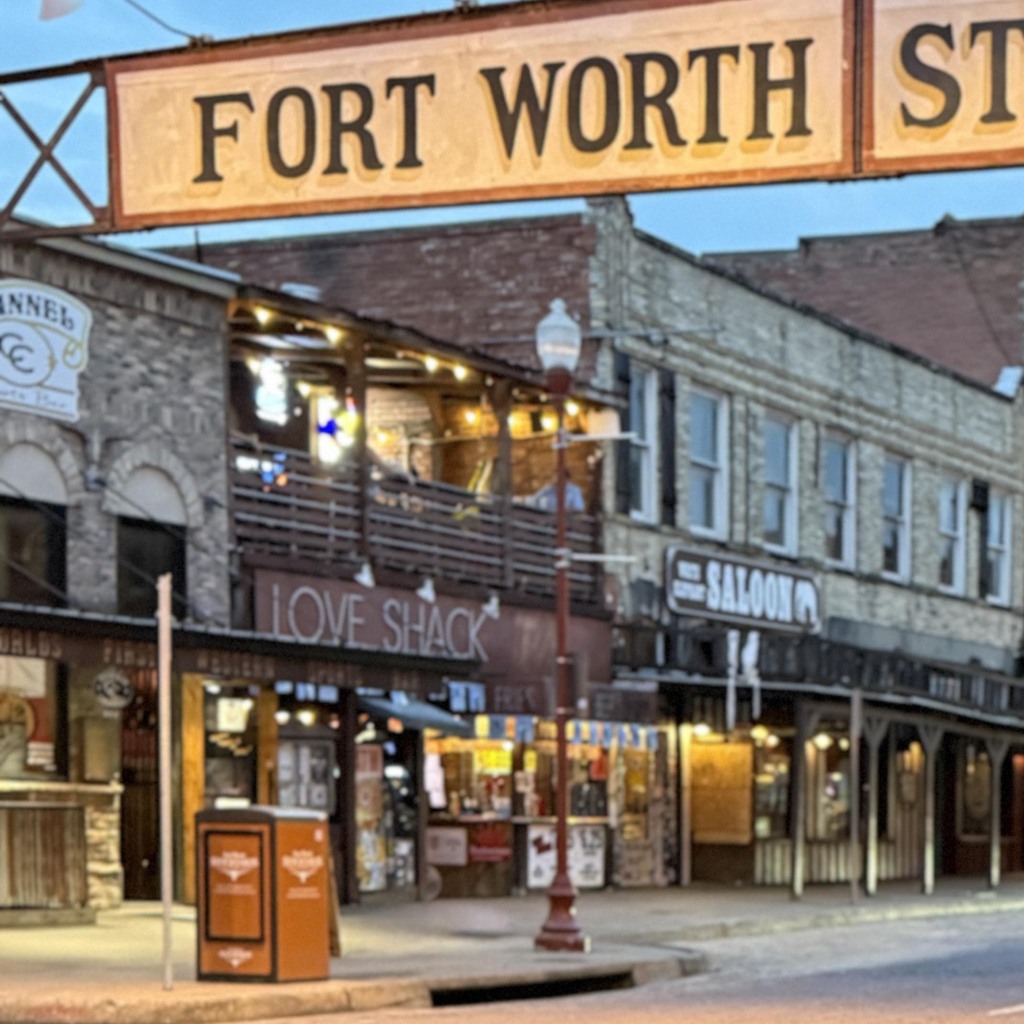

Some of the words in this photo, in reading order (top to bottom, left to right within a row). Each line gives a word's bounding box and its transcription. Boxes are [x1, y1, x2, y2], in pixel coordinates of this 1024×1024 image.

[192, 74, 436, 184] FORT
[480, 38, 815, 161] WORTH
[272, 584, 368, 650] LOVE
[383, 598, 489, 662] SHACK
[706, 560, 794, 622] SALOON
